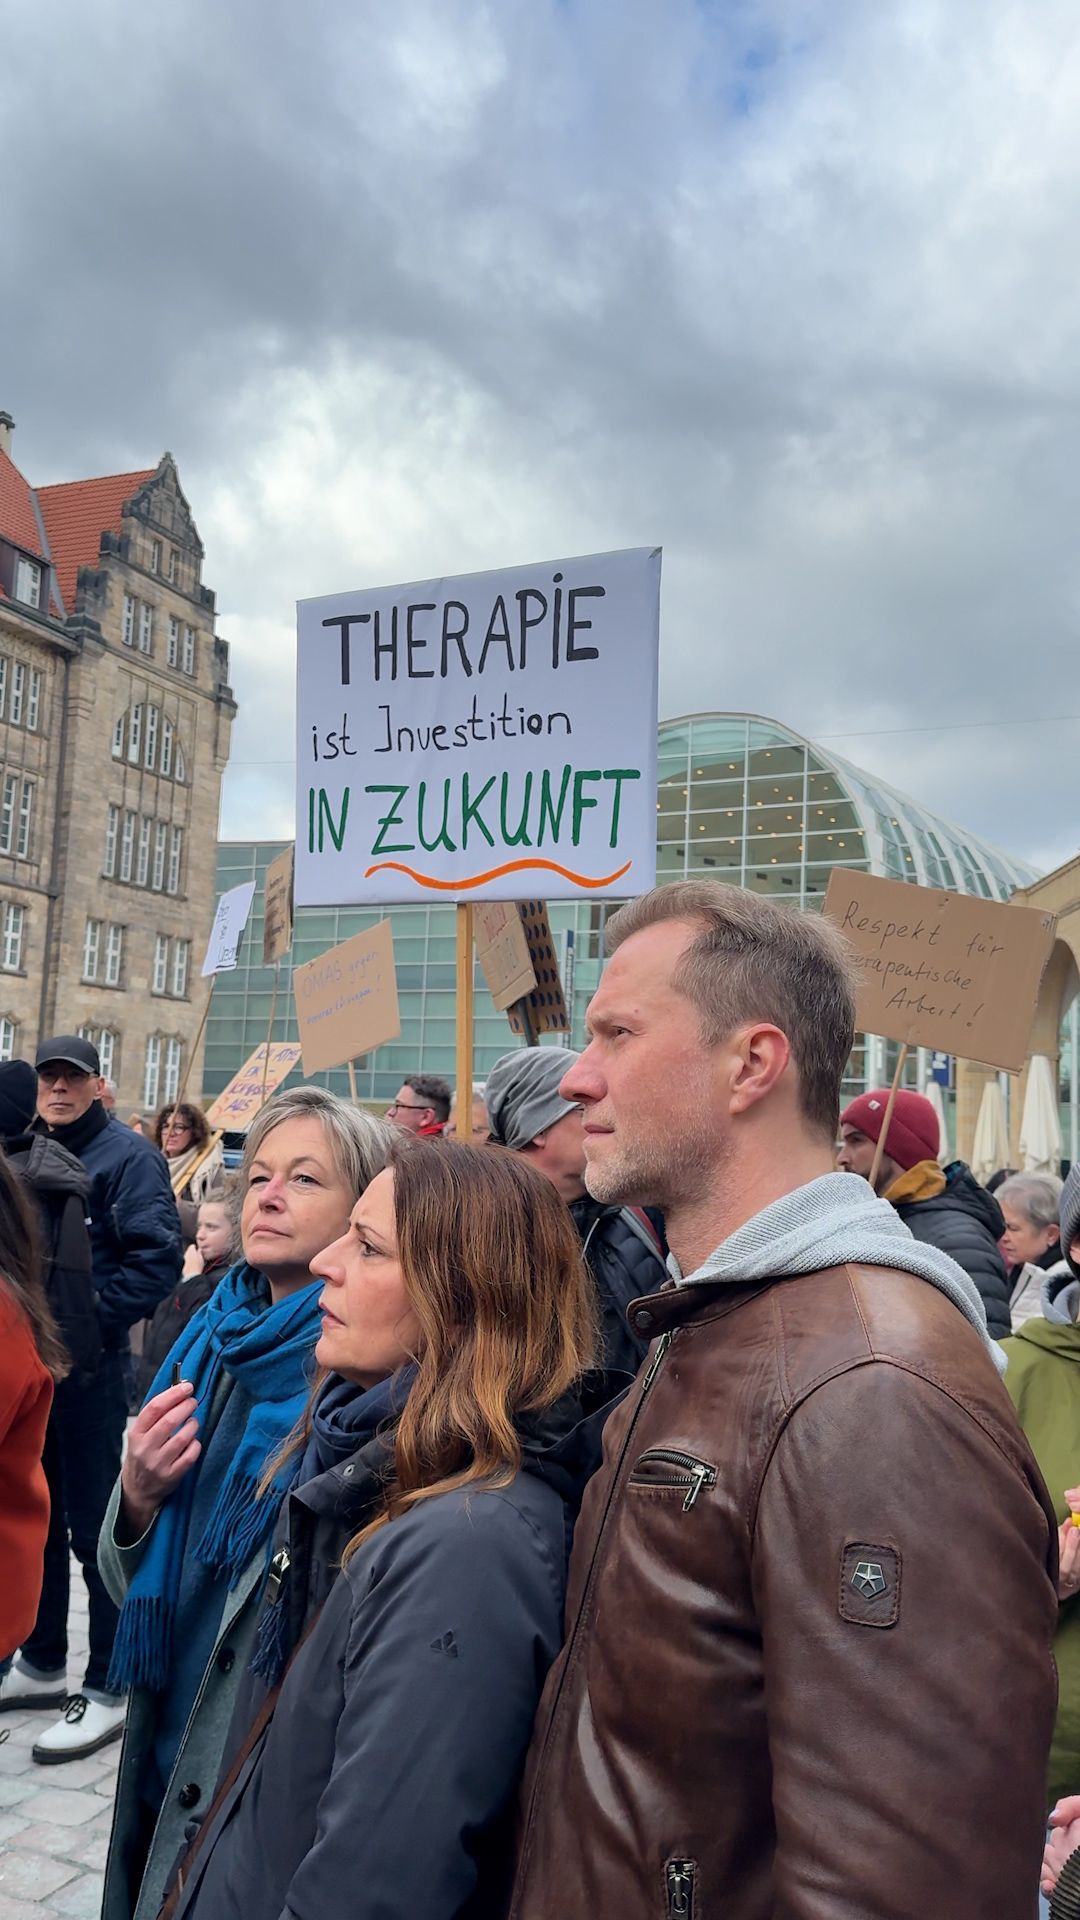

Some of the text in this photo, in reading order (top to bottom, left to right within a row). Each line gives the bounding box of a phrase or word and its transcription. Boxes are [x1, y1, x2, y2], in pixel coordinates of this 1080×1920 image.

[312, 713, 358, 762] ist
[308, 764, 641, 855] IN ZUKUNFT
[841, 900, 1004, 958] Respekt für
